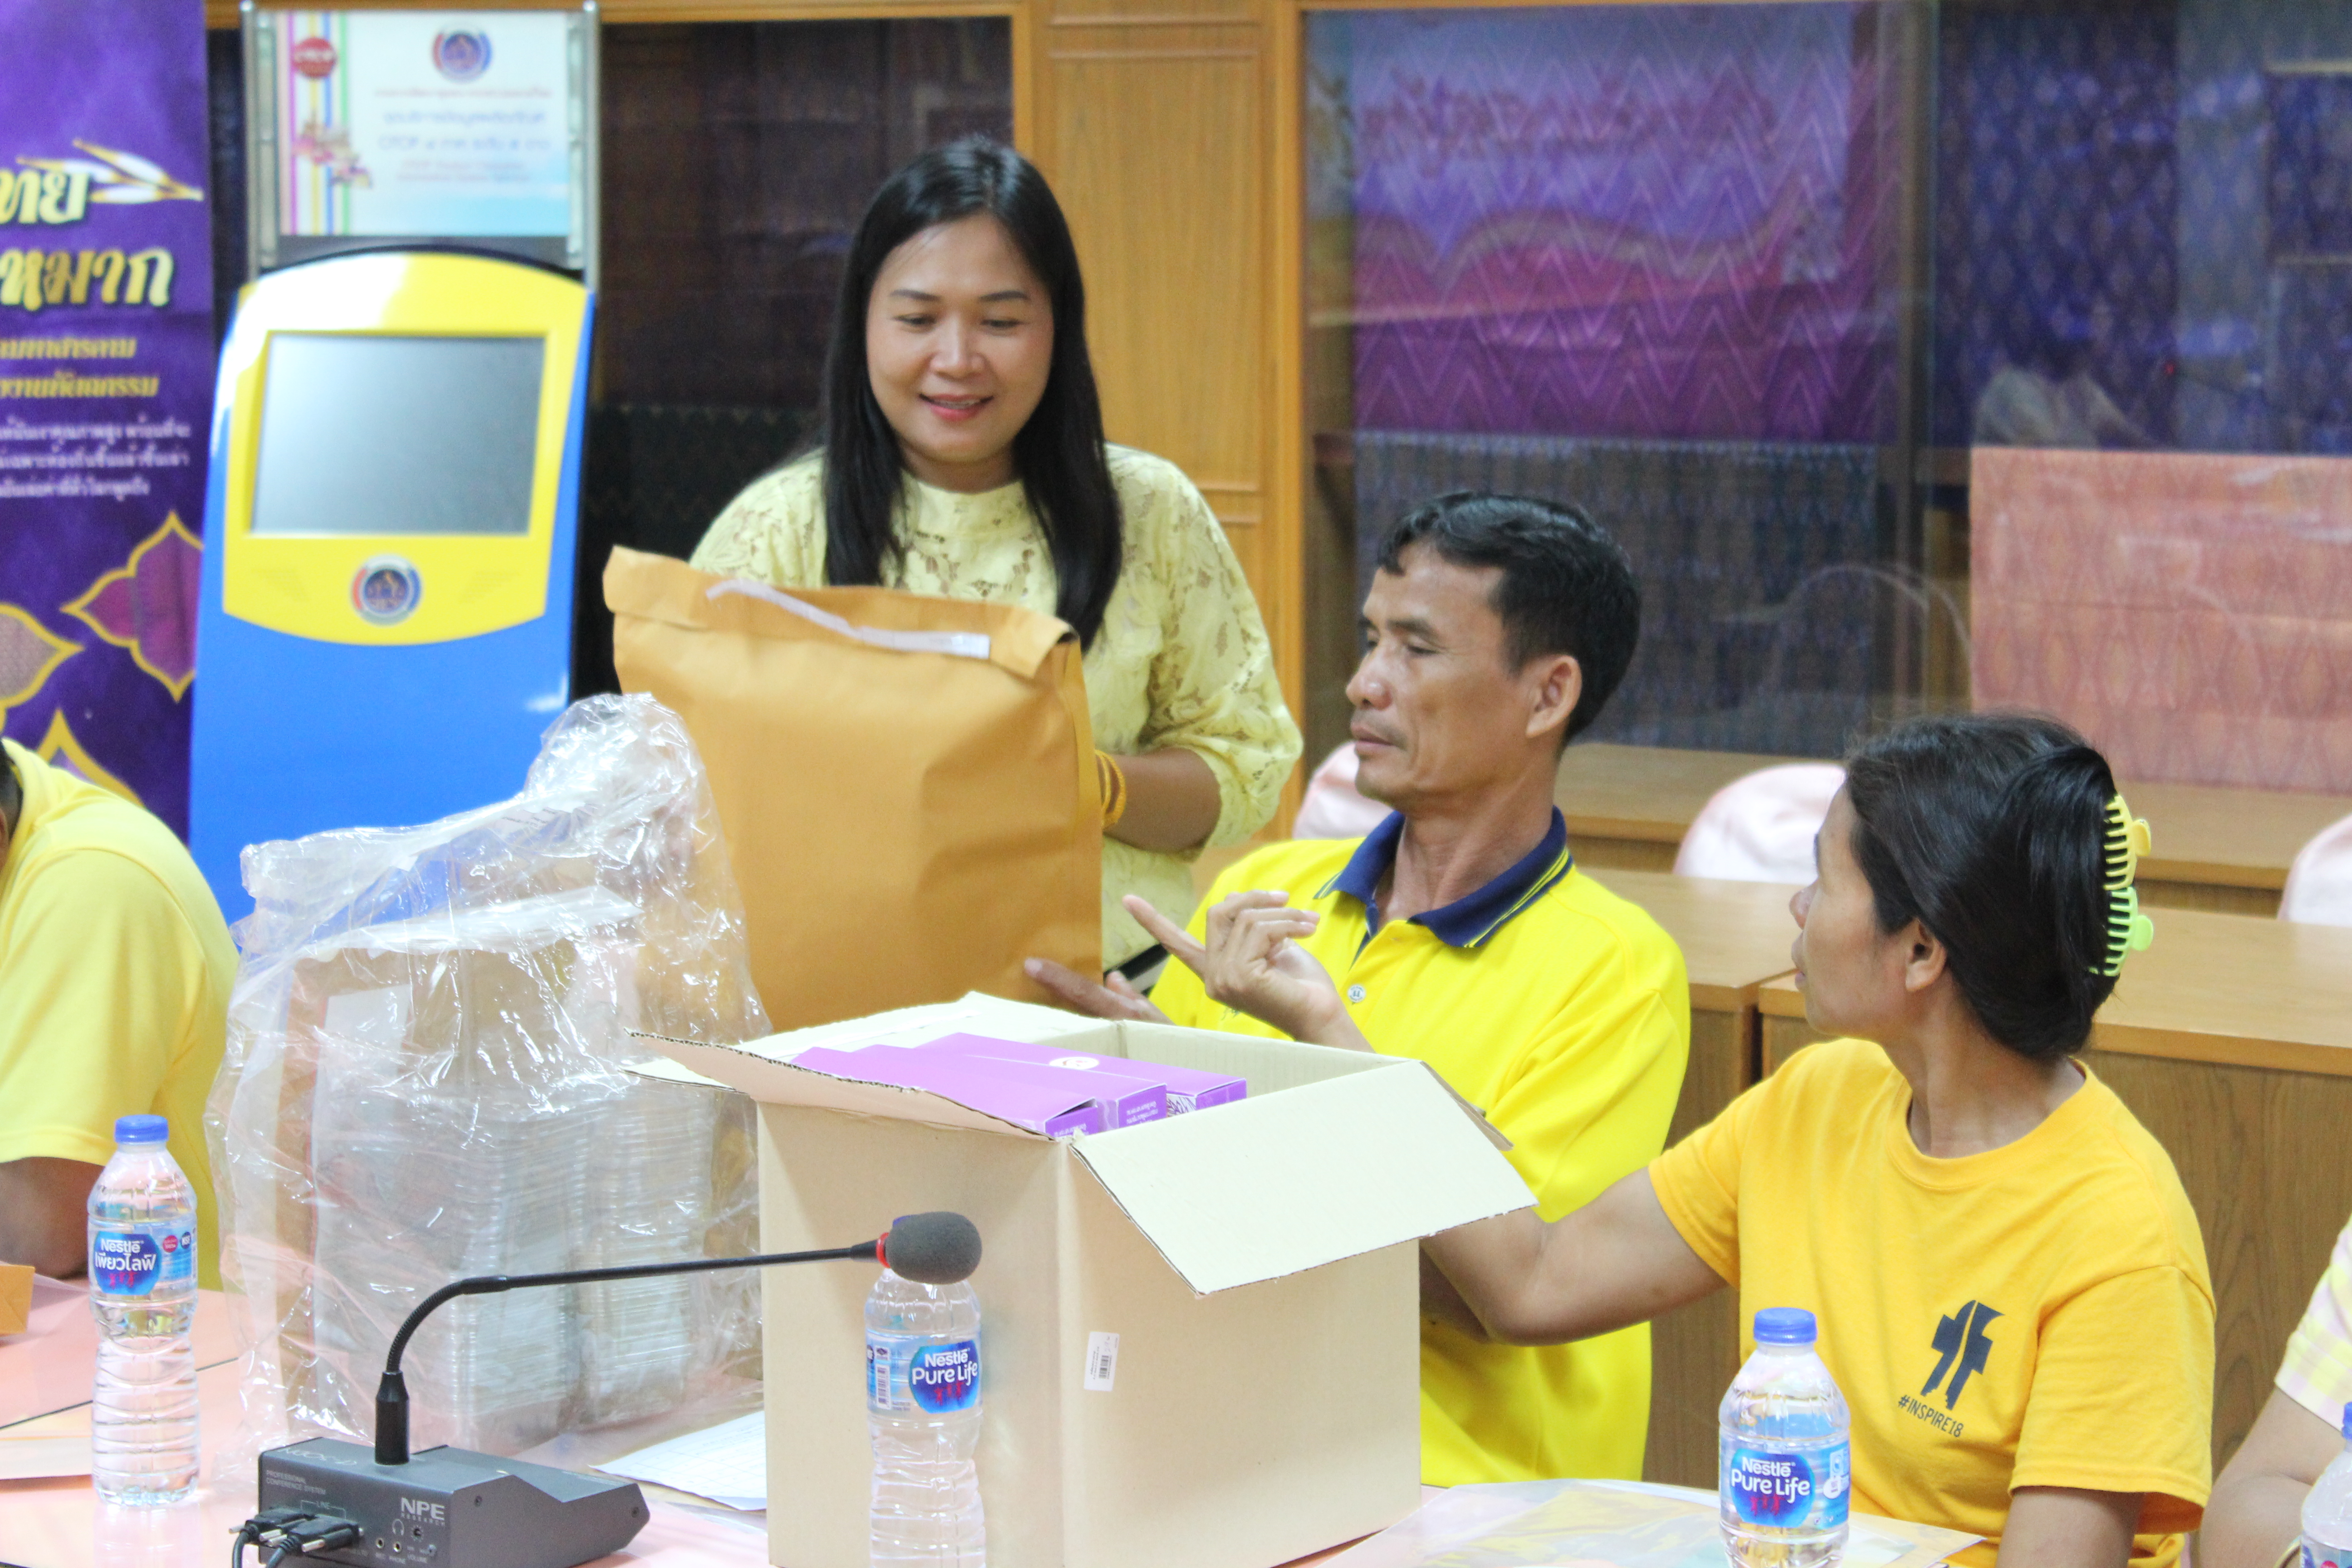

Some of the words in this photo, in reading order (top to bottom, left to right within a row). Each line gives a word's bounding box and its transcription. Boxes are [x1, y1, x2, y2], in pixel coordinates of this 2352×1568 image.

[912, 1367, 955, 1385] Pure
[957, 1361, 978, 1386] Life
[1898, 1394, 1964, 1437] #INSPIRE18
[1731, 1469, 1772, 1495] Pure
[1775, 1477, 1810, 1503] Life
[401, 1497, 446, 1520] NPE
